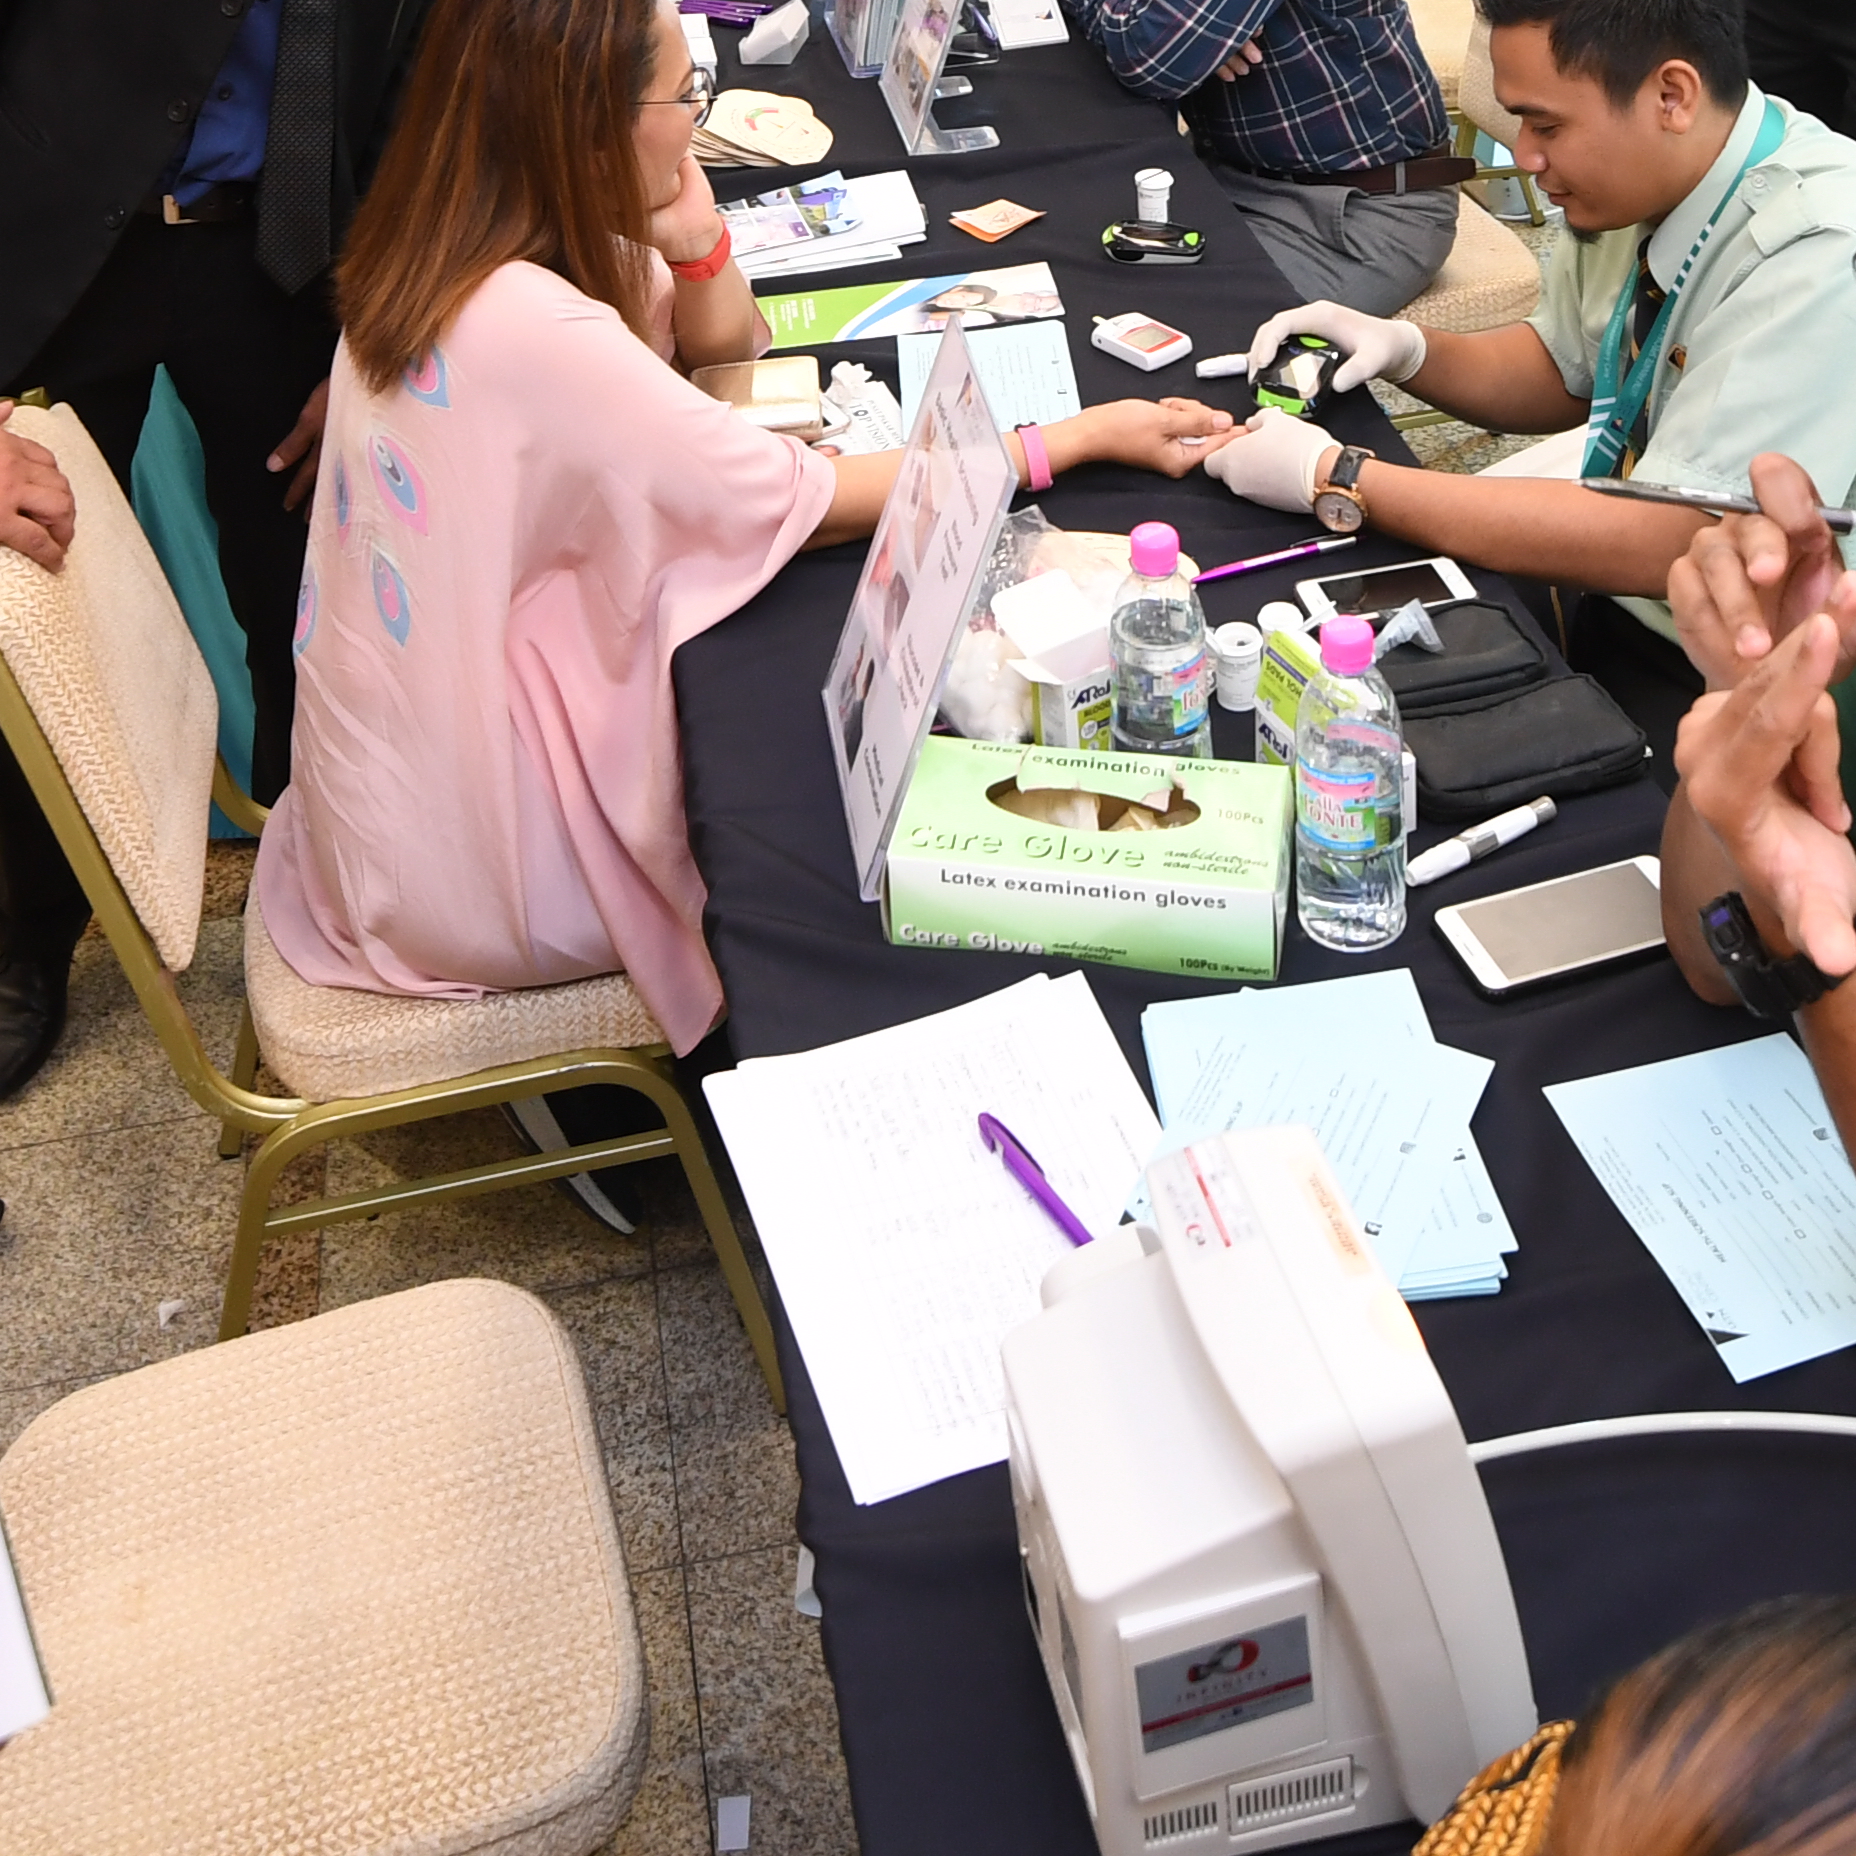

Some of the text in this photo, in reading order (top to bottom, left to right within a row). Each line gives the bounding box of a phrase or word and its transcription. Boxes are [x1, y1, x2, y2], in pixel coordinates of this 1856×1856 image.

[971, 742, 1241, 779] Latex examination gloves
[1217, 807, 1265, 826] 100Pcs
[911, 825, 1145, 868] Care Glove
[941, 868, 1228, 910] Latex examination gloves
[898, 923, 1044, 958] Care Glove
[1178, 956, 1219, 972] 100Pcs
